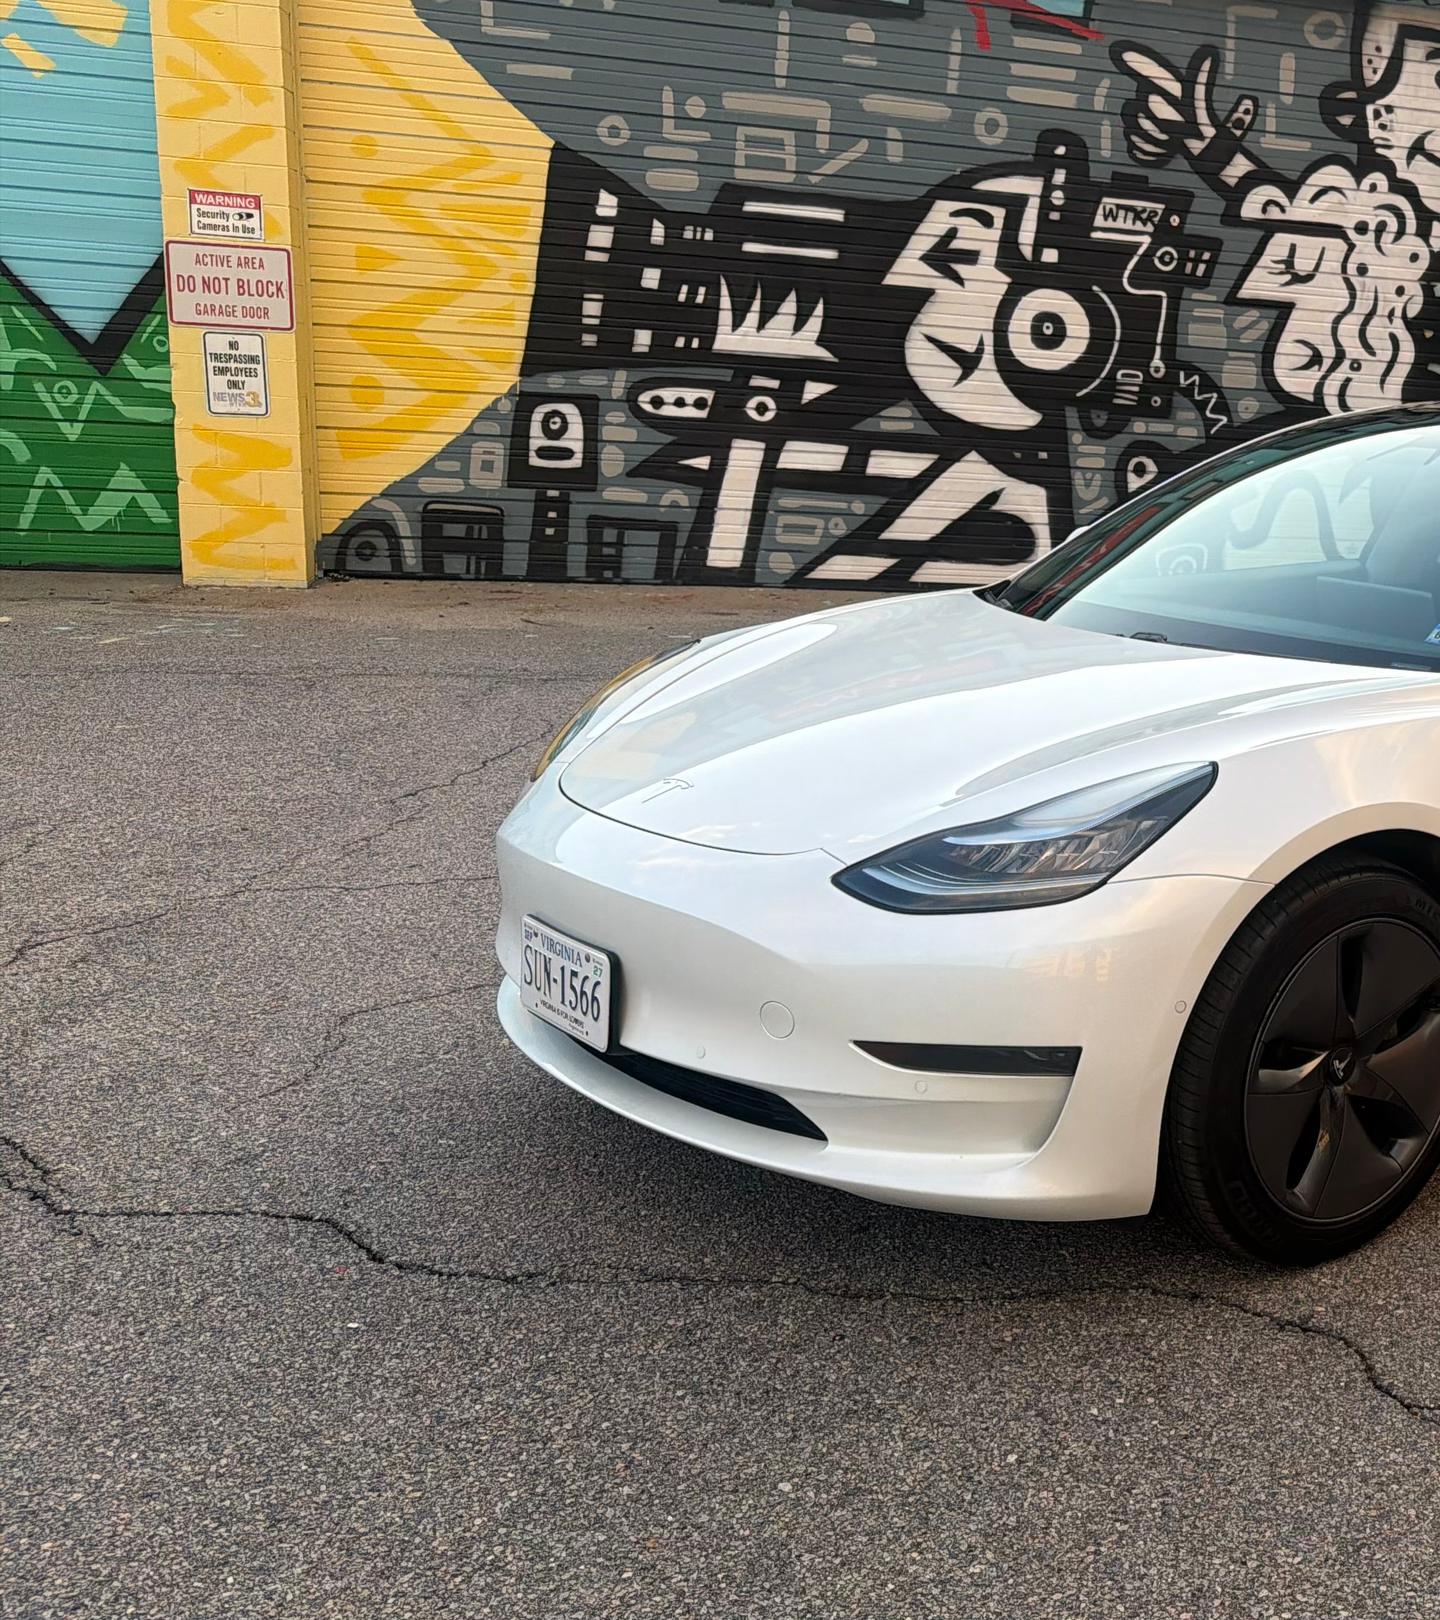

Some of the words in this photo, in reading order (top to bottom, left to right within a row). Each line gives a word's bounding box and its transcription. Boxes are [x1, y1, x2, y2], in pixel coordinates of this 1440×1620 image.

[195, 193, 255, 208] WARNING
[196, 208, 230, 222] Security
[1103, 204, 1159, 228] WTKR
[197, 221, 230, 232] Cameras
[232, 224, 239, 233] In
[241, 225, 255, 234] Use
[195, 253, 232, 268] ACTIVE
[236, 256, 264, 270] AREA
[176, 274, 196, 293] DO
[202, 276, 230, 295] NOT
[237, 278, 285, 299] BLOCK
[195, 302, 238, 318] GARAGE
[241, 306, 270, 320] DOOR
[228, 340, 239, 351] NO
[209, 352, 260, 365] TRESPASSING
[213, 366, 258, 378] EMPLOYEES
[226, 379, 245, 390] ONLY
[212, 391, 246, 402] NEWS
[245, 391, 260, 408] 3
[540, 933, 582, 968] VIRGINIA
[593, 965, 603, 977] 27
[523, 944, 602, 1022] SUN-1566
